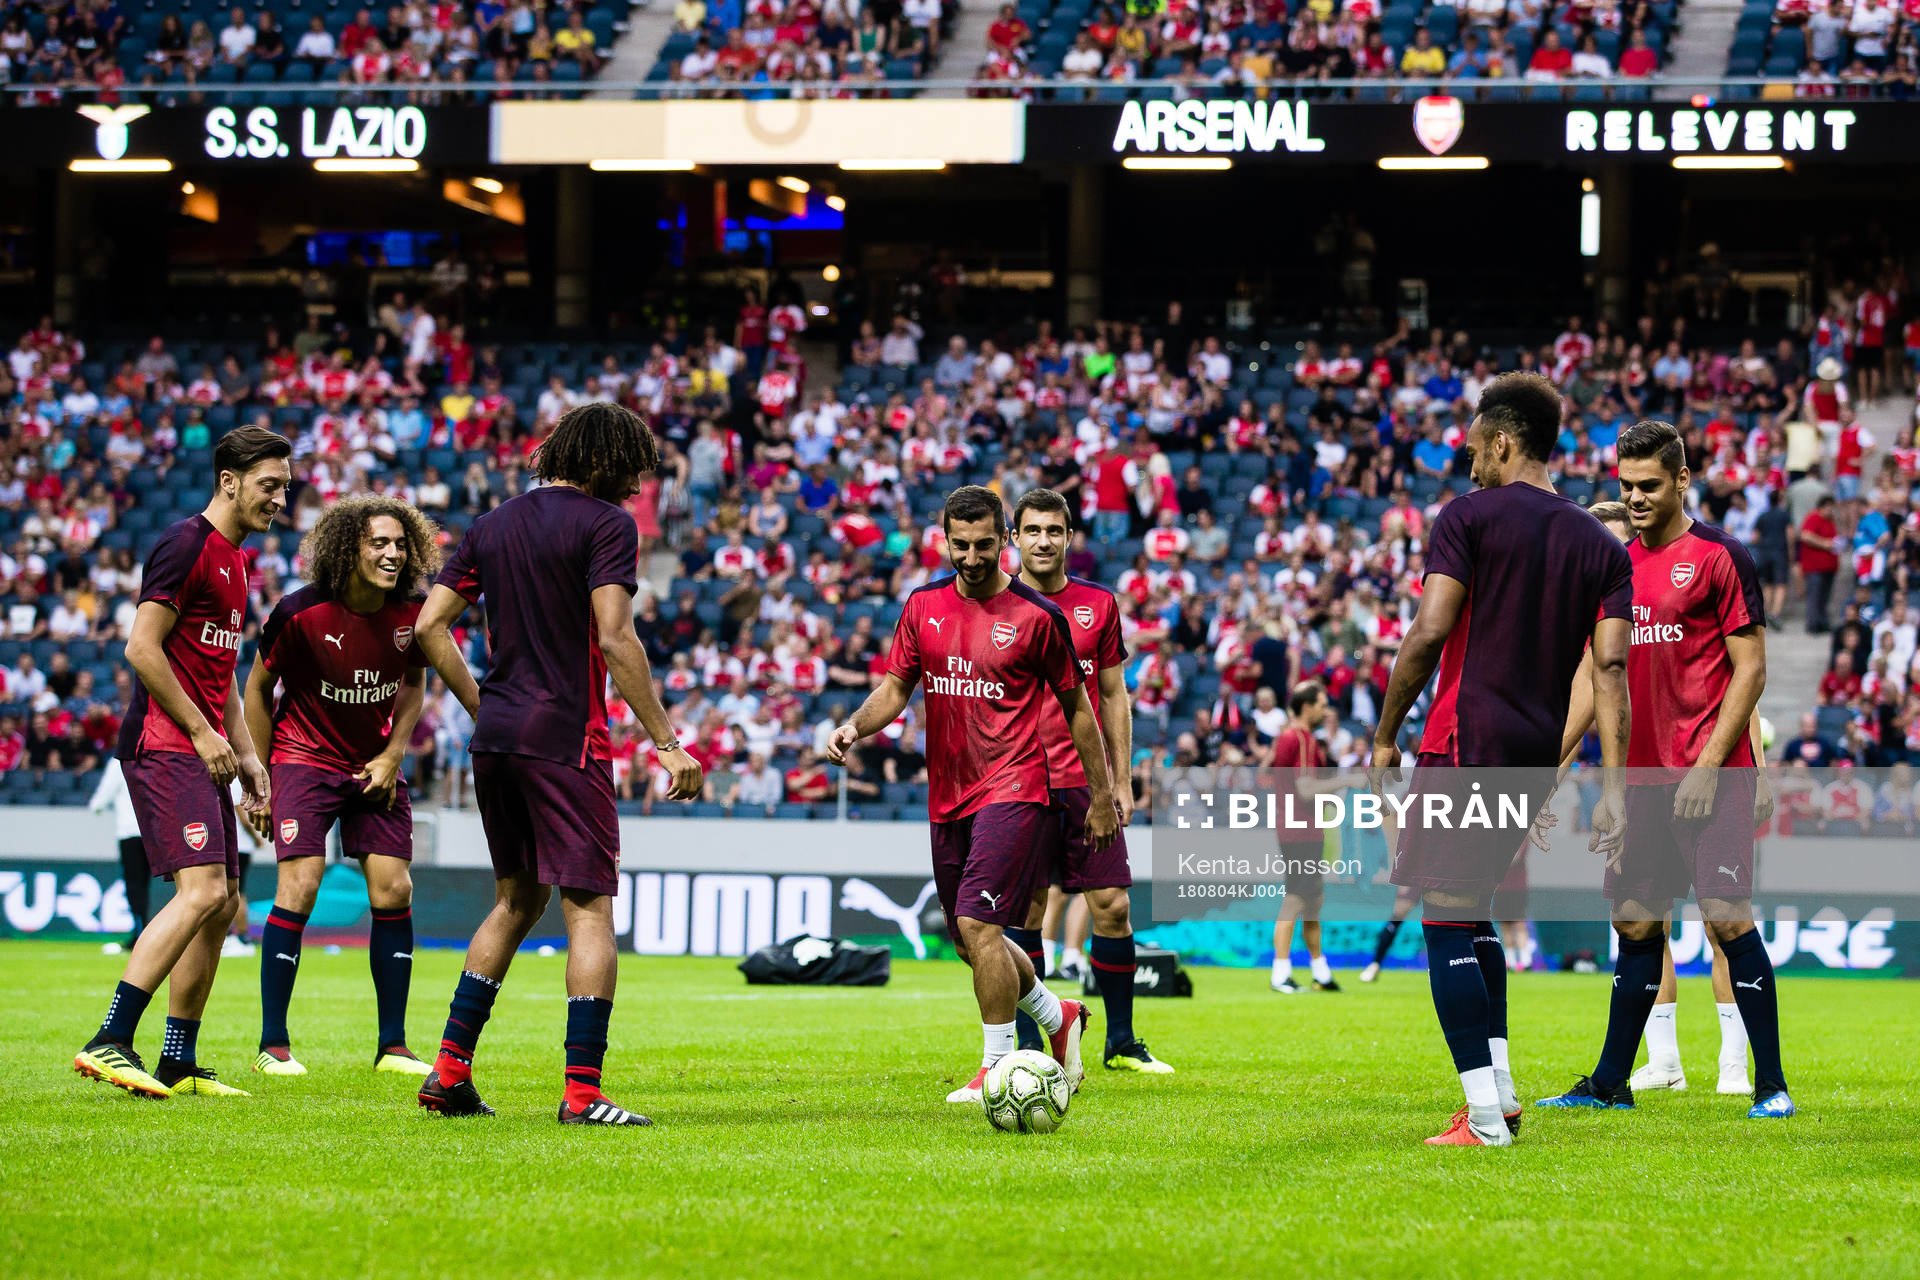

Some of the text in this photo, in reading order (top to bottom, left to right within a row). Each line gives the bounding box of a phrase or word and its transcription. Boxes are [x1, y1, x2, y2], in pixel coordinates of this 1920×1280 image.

[204, 106, 426, 159] S.S. LAZIO
[1112, 99, 1326, 153] ARSENAL
[1565, 109, 1857, 152] RELEVENT
[1631, 605, 1651, 623] Fly
[354, 669, 381, 686] Fly
[947, 655, 973, 677] Fly
[320, 679, 401, 704] Emirates
